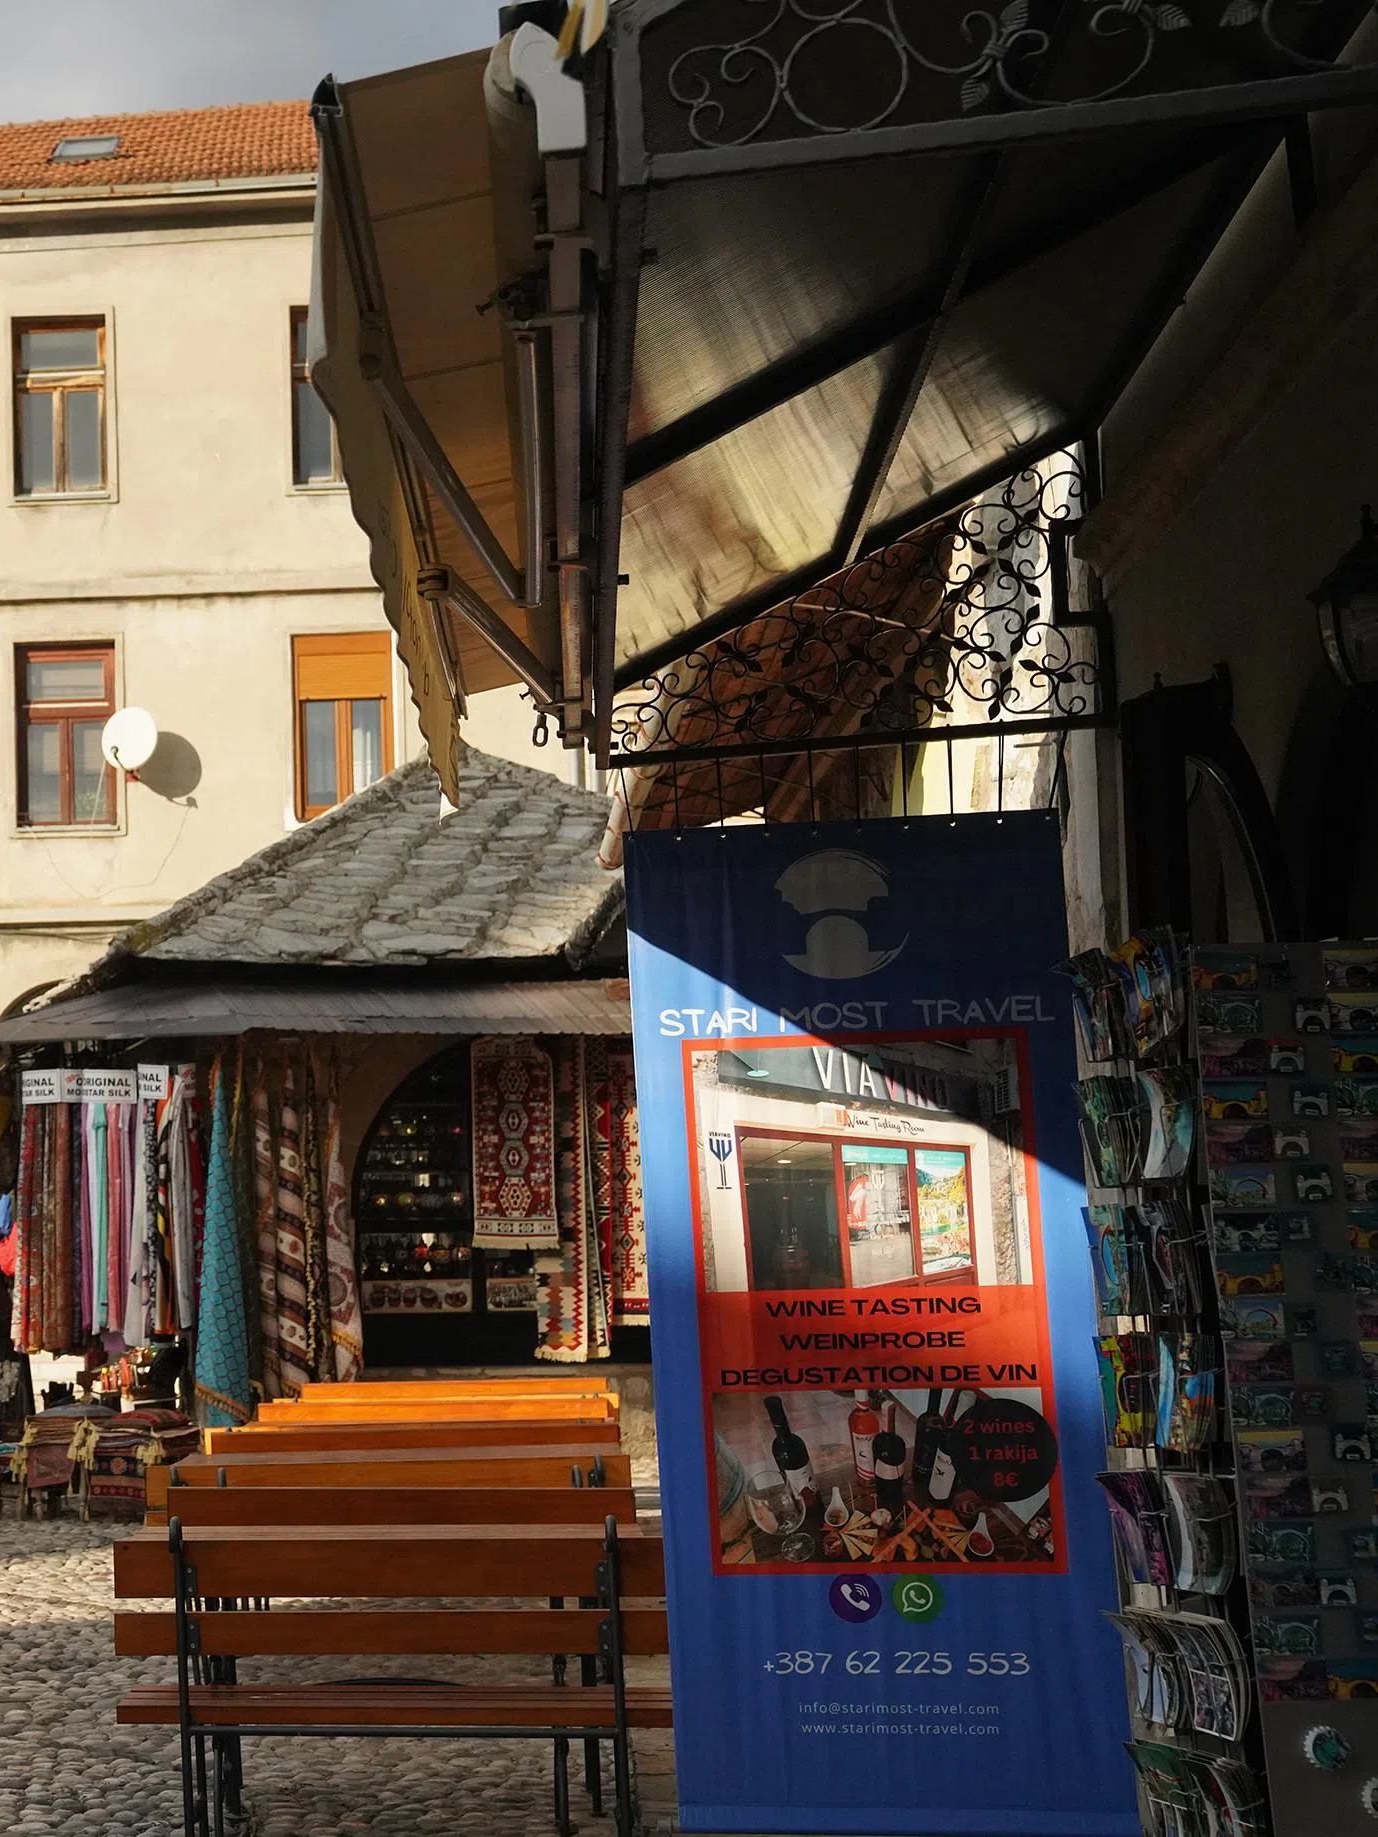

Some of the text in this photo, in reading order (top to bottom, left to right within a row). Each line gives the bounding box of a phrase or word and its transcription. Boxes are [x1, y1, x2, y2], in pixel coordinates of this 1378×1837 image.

[659, 995, 1055, 1036] STARI MOST TRAVEL
[76, 1077, 131, 1087] ORIGINAL
[35, 1088, 54, 1097] SILK
[108, 1088, 131, 1097] SILK
[765, 1296, 982, 1317] WINE TASTING
[778, 1331, 966, 1350] WEINPROBE
[941, 1365, 981, 1382] DE
[986, 1363, 1038, 1382] VIN
[963, 1419, 1036, 1434] 2 wines
[970, 1446, 980, 1461] 1
[985, 1445, 1039, 1464] rakija
[993, 1471, 1019, 1488] 8€
[763, 1650, 1030, 1676] +387 62 225 553
[799, 1702, 999, 1715] info@starimost-travel.com
[802, 1723, 999, 1735] www.starimost-travel.com
